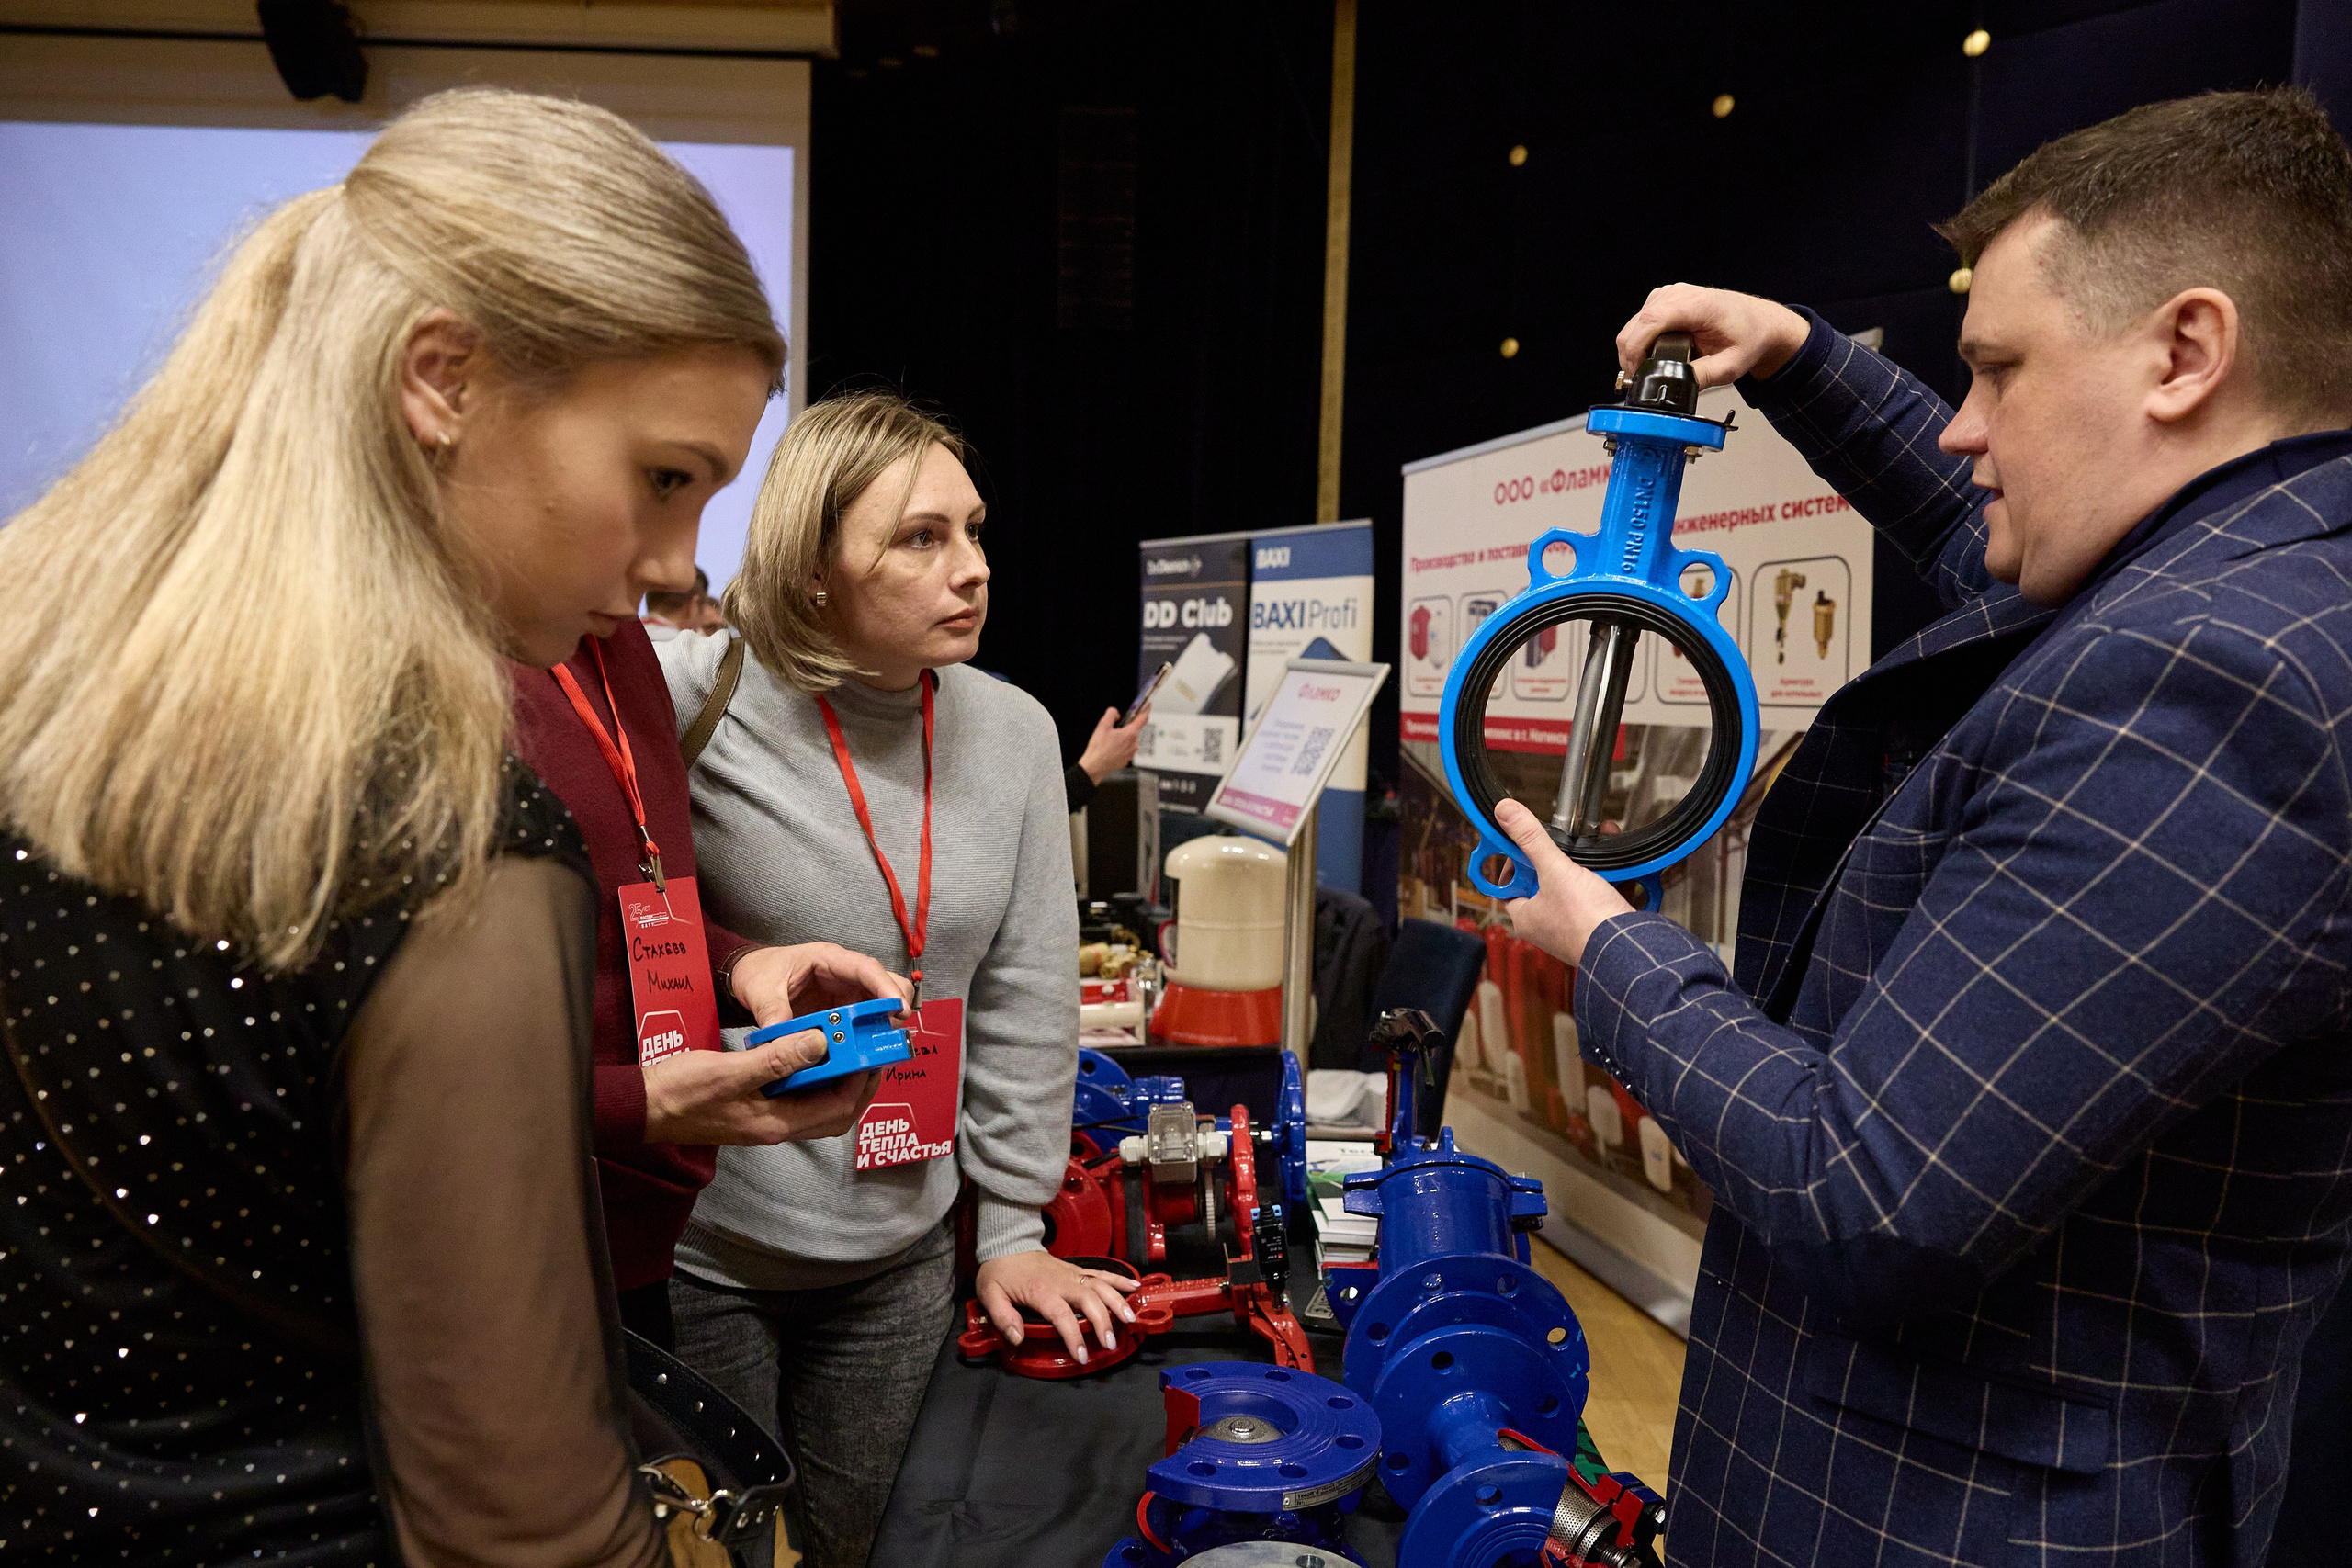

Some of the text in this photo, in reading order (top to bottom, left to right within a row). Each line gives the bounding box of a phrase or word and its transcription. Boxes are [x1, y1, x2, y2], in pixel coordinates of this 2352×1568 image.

[1494, 476, 1534, 505] ООО
[1781, 493, 1851, 521] систем
[1621, 477, 1656, 575] DN150 PN16
[1143, 596, 1233, 629] DD Club
[641, 1030, 684, 1062] ДЕНЬ
[859, 1133, 919, 1154] ТЕПЛА
[860, 1118, 910, 1141] ДЕНЬ
[856, 1140, 952, 1168] И СЧАСТЬЯ
